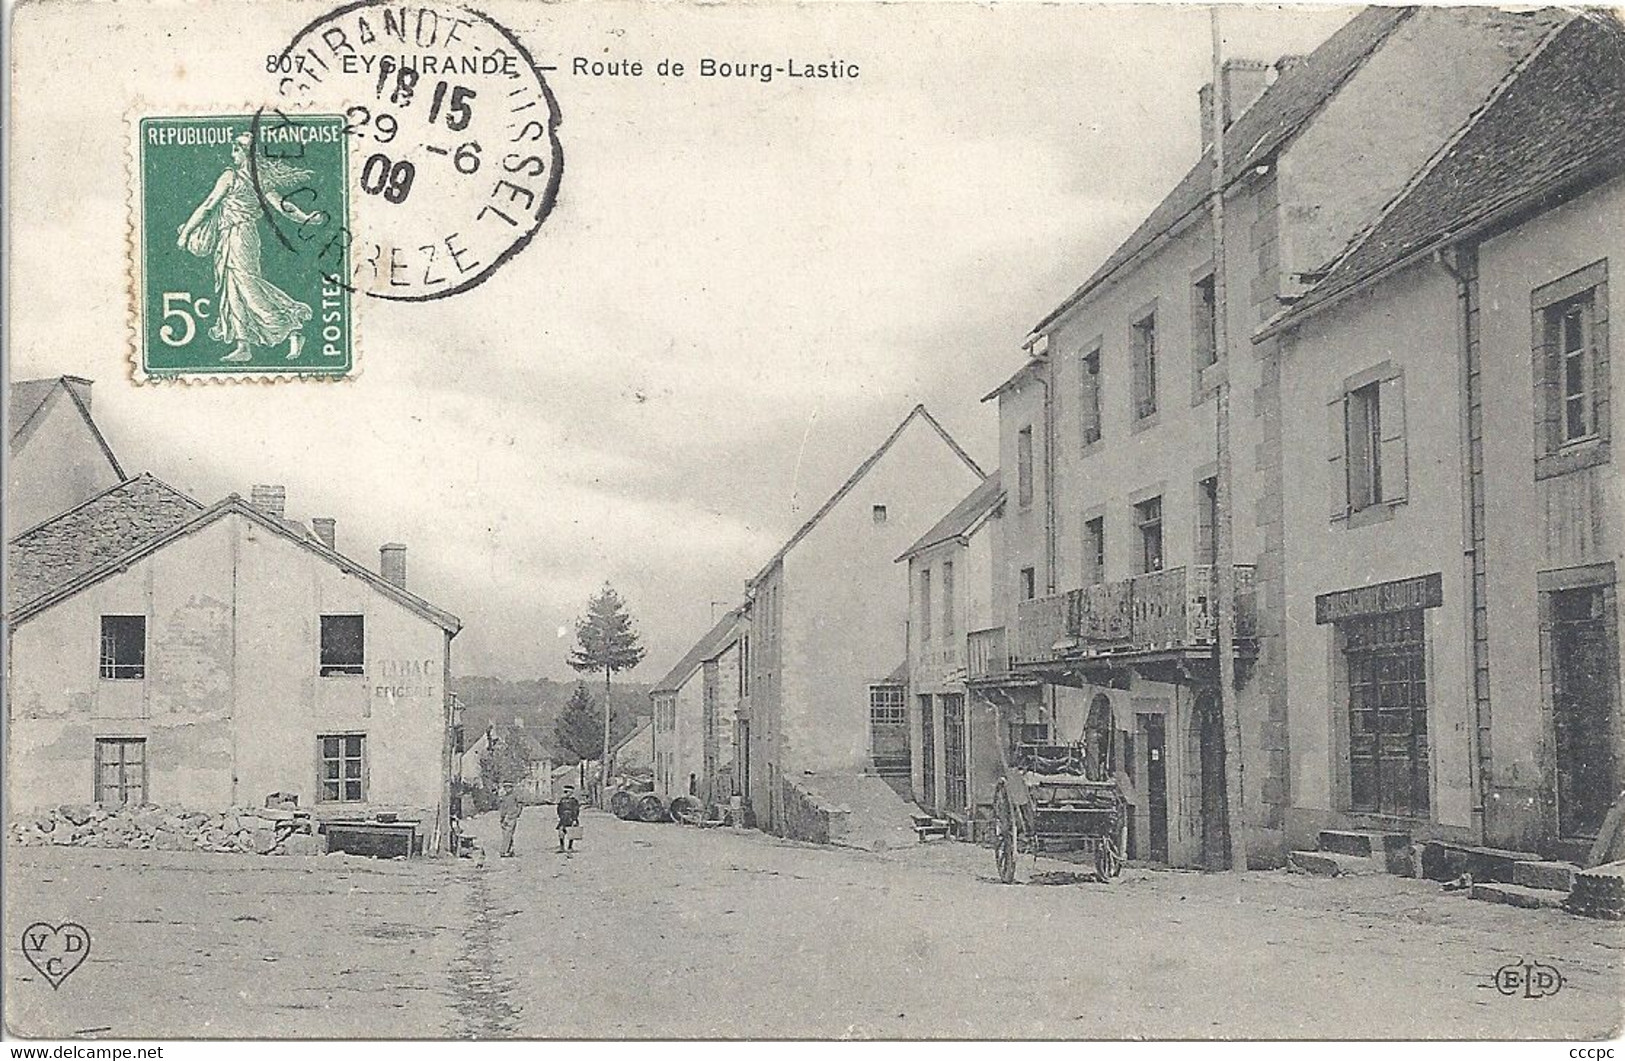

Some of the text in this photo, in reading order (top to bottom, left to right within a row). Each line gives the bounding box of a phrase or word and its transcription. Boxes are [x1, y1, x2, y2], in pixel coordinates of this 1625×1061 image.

[342, 105, 398, 143] 29
[428, 81, 477, 131] 15
[259, 125, 341, 146] FRANÇAISE
[360, 153, 416, 204] 09
[322, 273, 342, 356] POSTES
